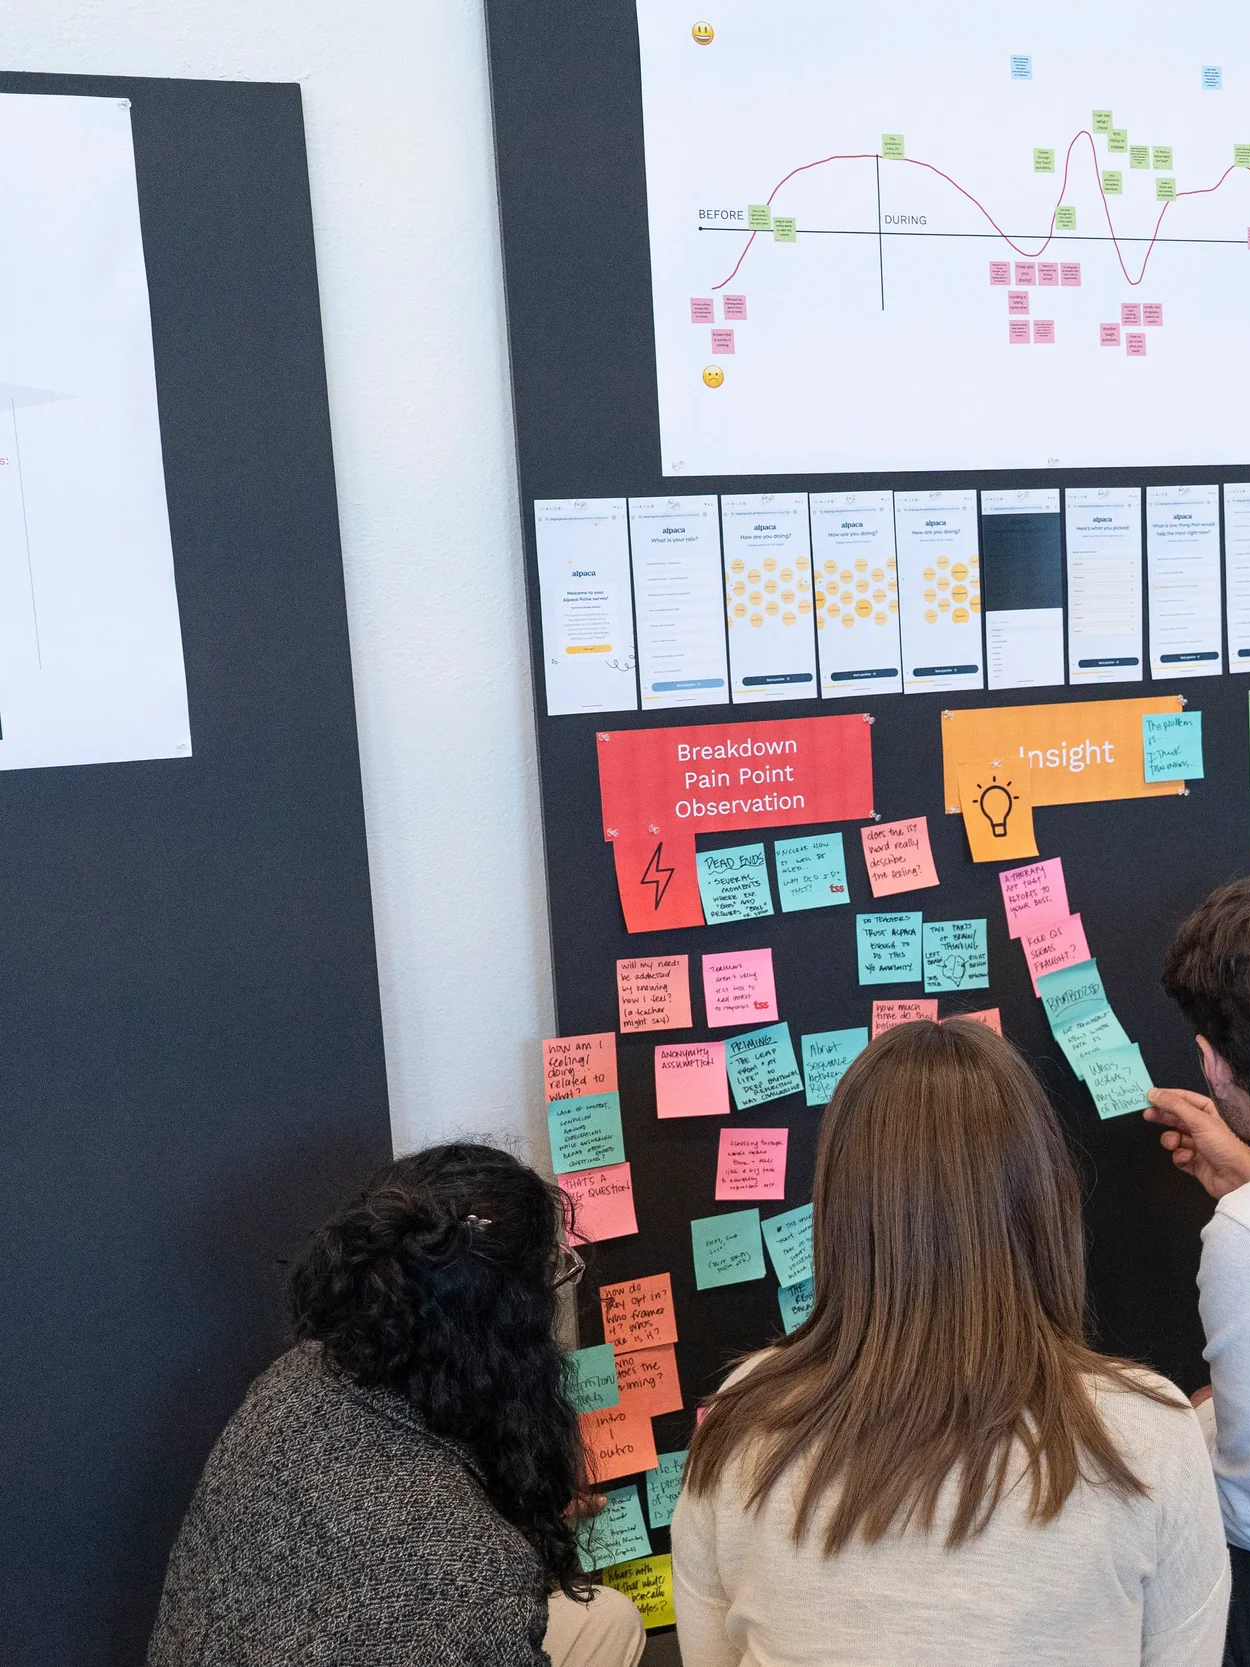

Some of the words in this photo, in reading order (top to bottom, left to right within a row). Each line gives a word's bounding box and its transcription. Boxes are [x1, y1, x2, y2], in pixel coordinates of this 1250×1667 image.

[699, 210, 744, 220] BEFORE
[885, 215, 927, 225] DURING
[754, 524, 777, 532] alpaca
[572, 570, 596, 578] alpaca
[677, 737, 798, 762] Breakdown
[684, 768, 730, 790] Pain
[739, 762, 794, 786] Point
[675, 793, 805, 819] Observation
[867, 829, 886, 840] does
[889, 828, 903, 836] the
[868, 842, 890, 853] word
[895, 838, 919, 851] really
[704, 856, 734, 870] DEAD
[739, 853, 764, 867] ENDS
[870, 854, 906, 868] describe
[1011, 865, 1047, 881] THERAPY
[714, 874, 755, 885] SEVERAL
[1006, 884, 1018, 892] APP
[1023, 877, 1041, 888] THAT
[721, 882, 761, 893] MOMENTS
[829, 884, 844, 893] tss
[1008, 891, 1037, 904] REPORTS
[876, 915, 911, 923] TEACHERS
[863, 928, 886, 938] TRUST
[892, 928, 916, 936] ALPACA
[952, 923, 972, 931] PARTS
[870, 941, 896, 949] ENOUGH
[889, 951, 905, 959] THIS
[925, 951, 940, 959] LEFT
[1031, 945, 1056, 959] SEEMS
[1034, 945, 1076, 972] FRAUGHT?
[621, 960, 637, 969] will
[641, 962, 653, 970] my
[621, 972, 631, 981] be
[635, 971, 671, 979] addressed
[715, 974, 736, 982] aren't
[622, 985, 633, 994] by
[637, 984, 668, 992] knowing
[651, 993, 672, 1003] feel?
[876, 1004, 894, 1012] how
[624, 1017, 647, 1029] might
[548, 1040, 571, 1054] how
[730, 1035, 772, 1053] PRIMING
[736, 1057, 751, 1065] THE
[550, 1077, 587, 1089] related
[593, 1074, 605, 1083] to
[743, 1082, 764, 1093] DEEP
[560, 1114, 592, 1126] CONFUSION
[563, 1173, 595, 1190] THAT'S
[588, 1181, 630, 1198] QUESTION
[604, 1288, 625, 1297] how
[629, 1283, 641, 1294] do
[631, 1295, 646, 1305] opt
[651, 1289, 667, 1301] in?
[630, 1307, 665, 1320] frames
[646, 1328, 660, 1339] it?
[600, 1444, 634, 1459] outro
[636, 1562, 652, 1575] with
[623, 1580, 638, 1592] that
[642, 1575, 665, 1588] white
[632, 1587, 665, 1601] beneath
